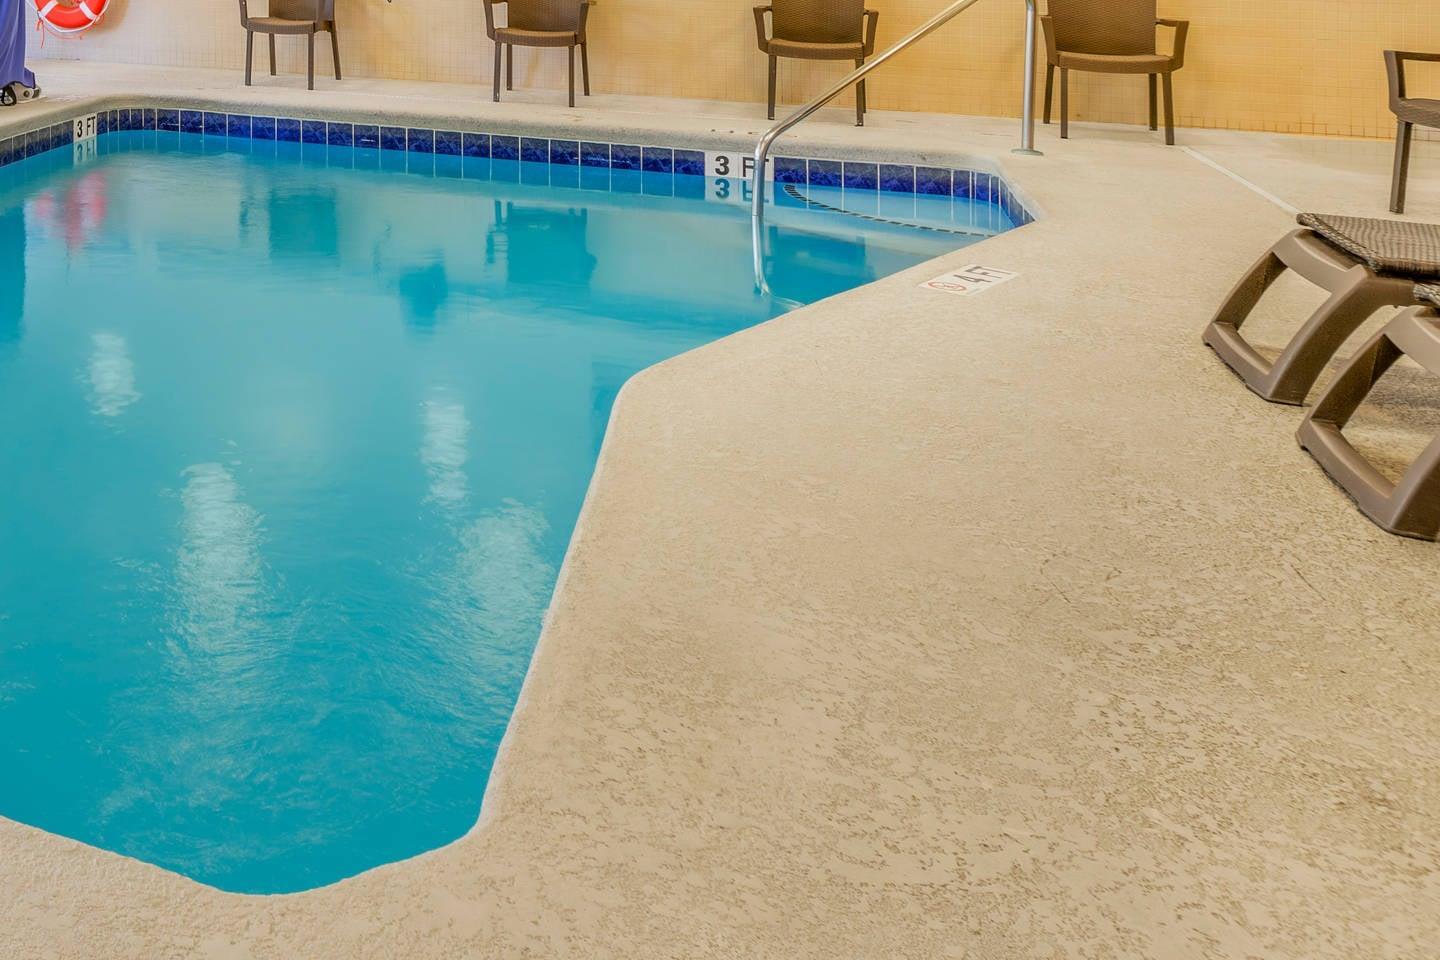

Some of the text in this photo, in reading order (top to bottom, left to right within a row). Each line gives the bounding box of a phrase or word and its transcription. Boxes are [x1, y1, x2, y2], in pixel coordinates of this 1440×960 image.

[77, 116, 96, 138] 3 FT
[715, 155, 730, 176] 3
